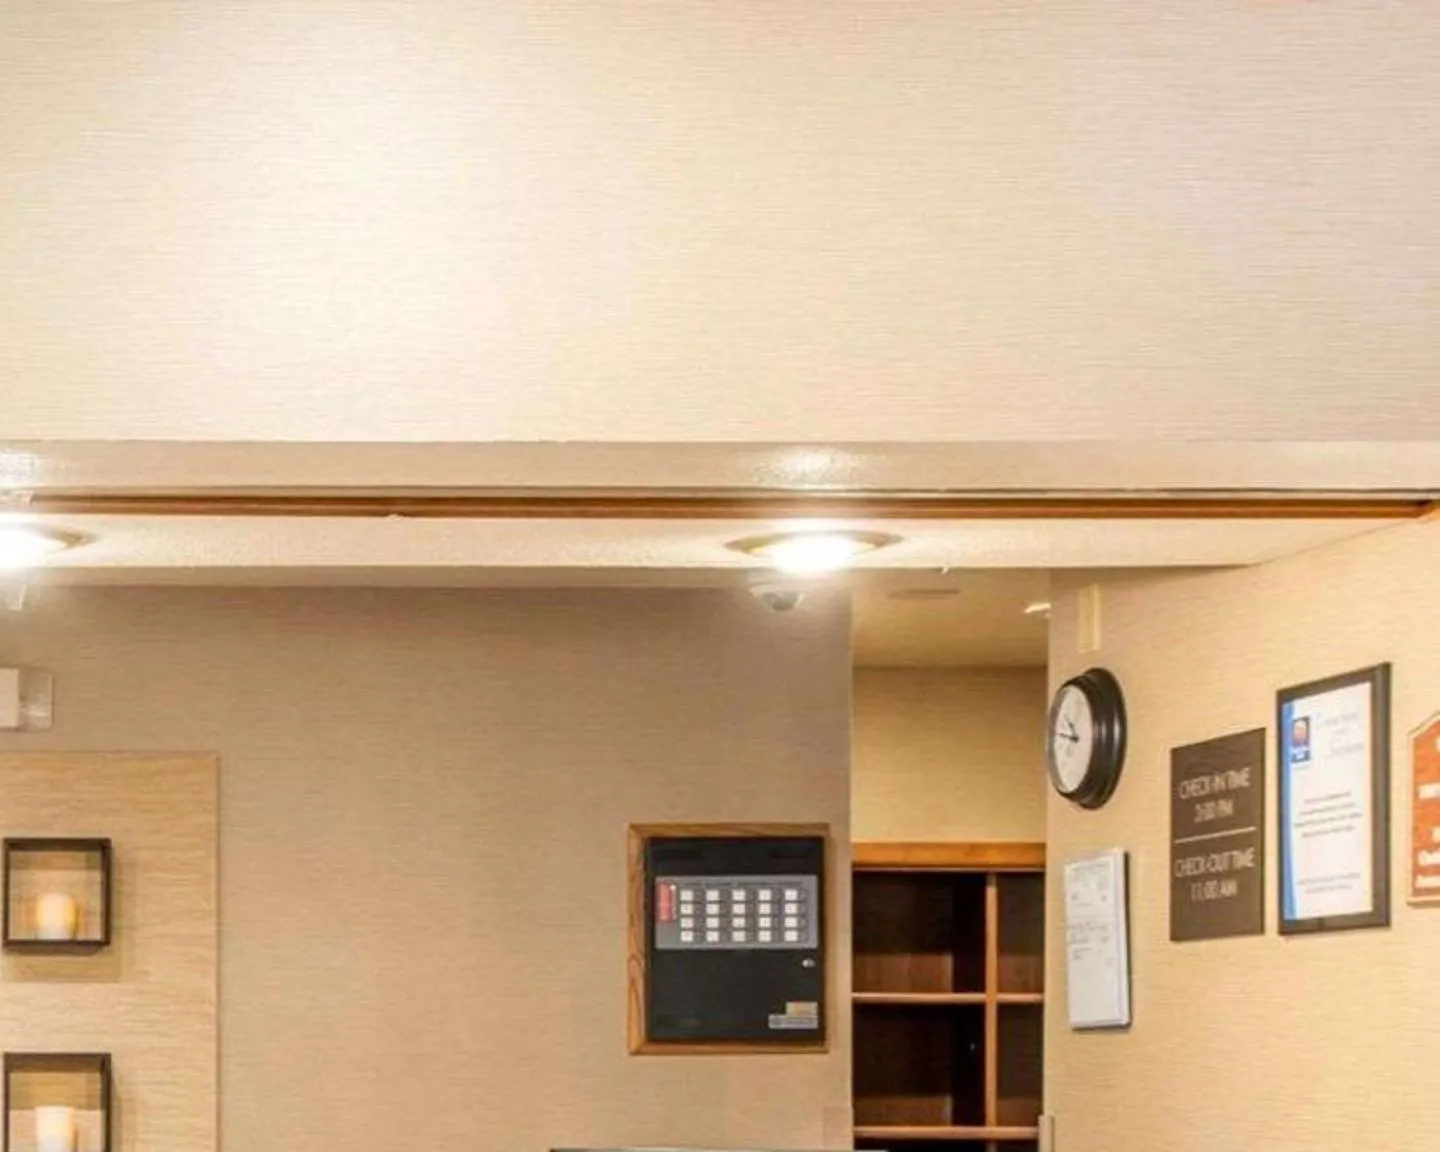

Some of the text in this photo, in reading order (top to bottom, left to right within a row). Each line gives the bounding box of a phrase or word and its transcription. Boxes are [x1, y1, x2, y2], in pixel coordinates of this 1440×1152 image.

[1228, 766, 1251, 789] TIME
[1218, 799, 1234, 818] PM
[1174, 847, 1255, 877] CHECK-OUT TIME
[1219, 879, 1238, 899] AM
